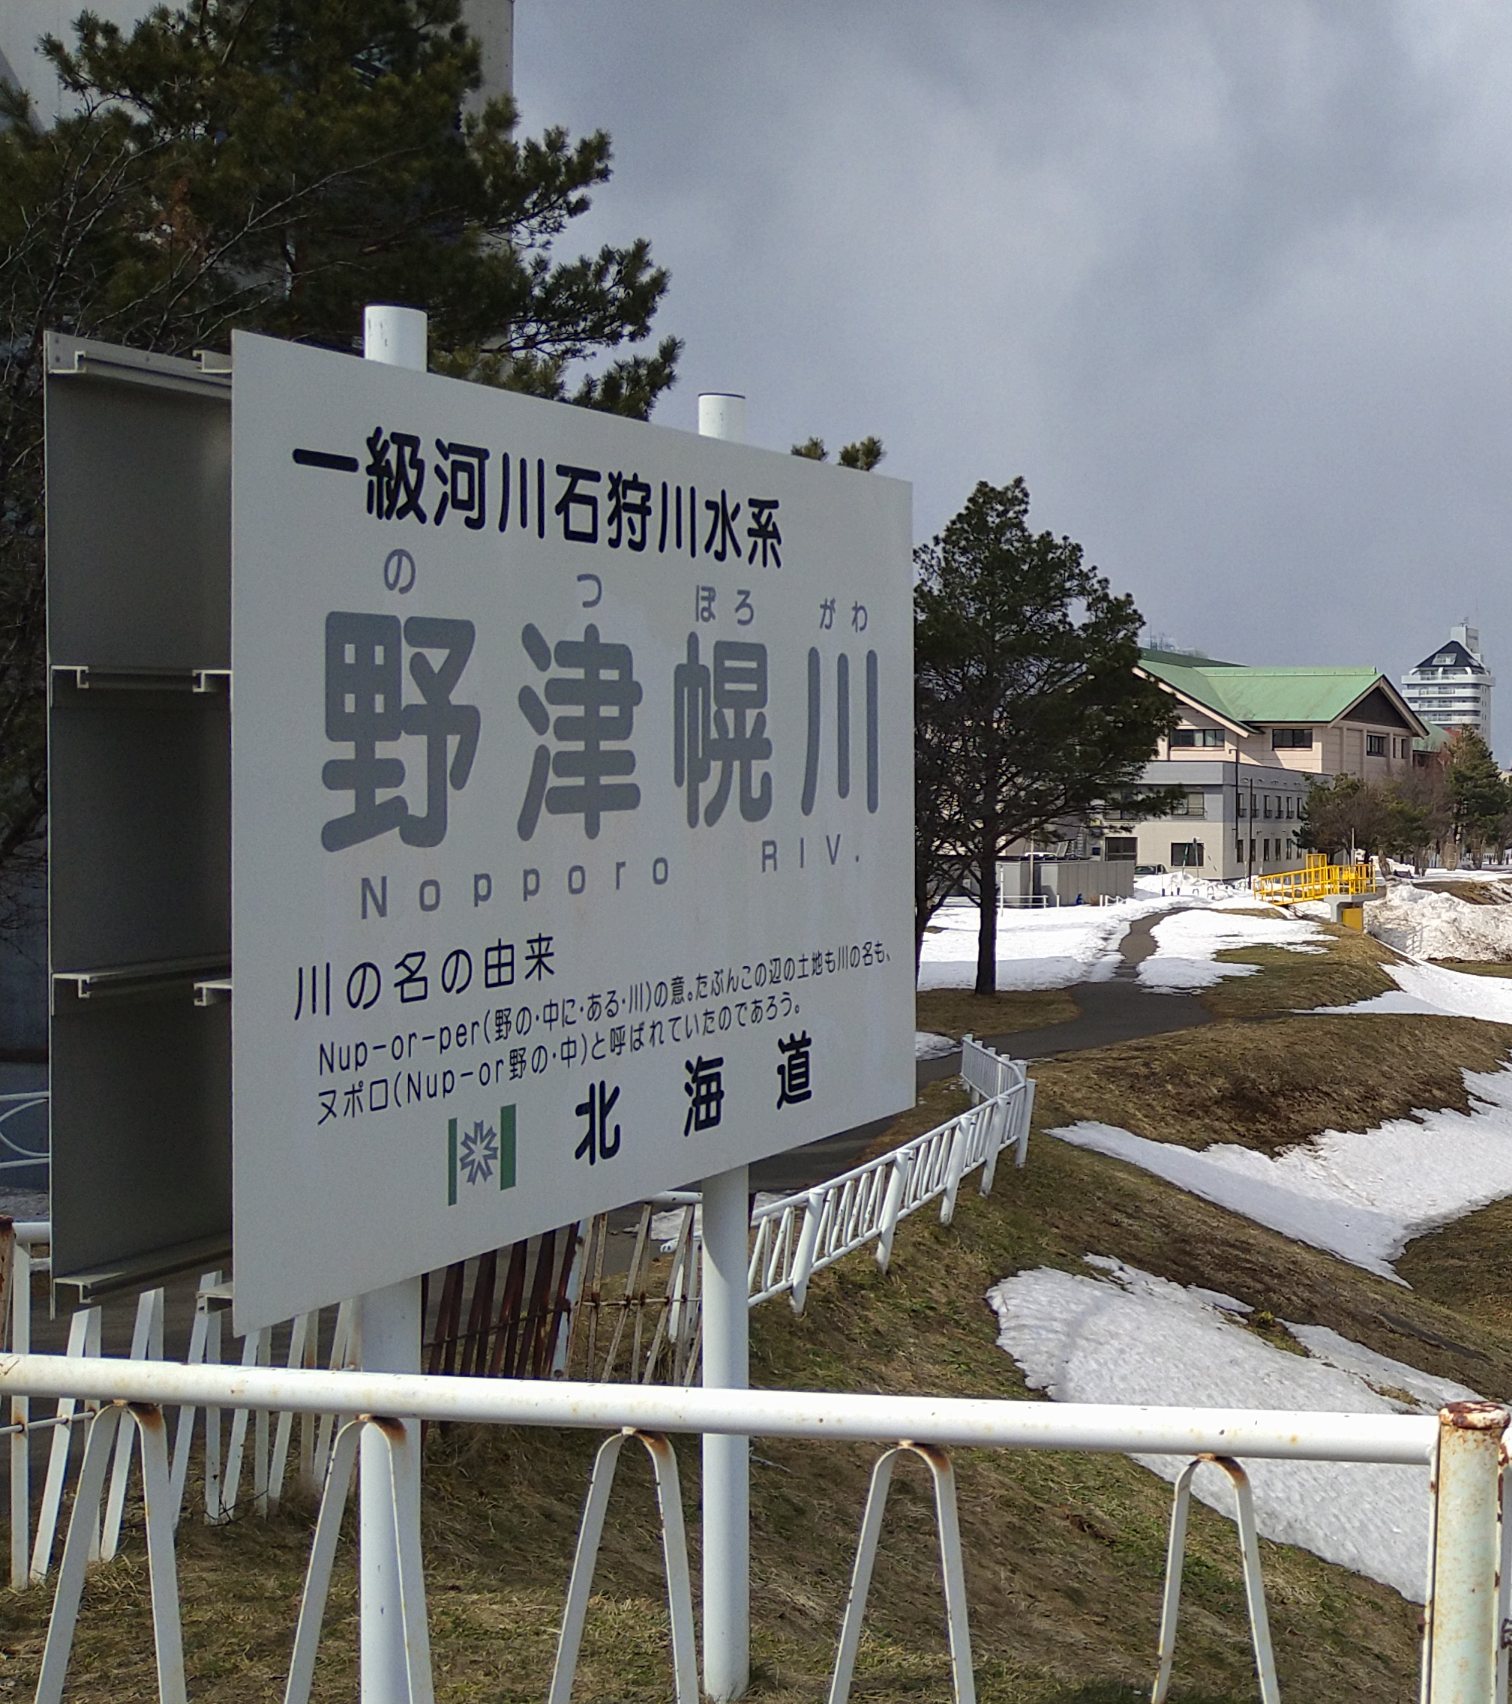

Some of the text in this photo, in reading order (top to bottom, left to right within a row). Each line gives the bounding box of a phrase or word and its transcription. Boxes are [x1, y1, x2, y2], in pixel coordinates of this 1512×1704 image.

[292, 426, 782, 568] 一級河川石狩川水系
[321, 611, 878, 852] 野津幌川
[360, 834, 861, 919] Nopporo RIV.
[294, 932, 555, 1020] 川の名の由来
[575, 1030, 812, 1166] 北海道
